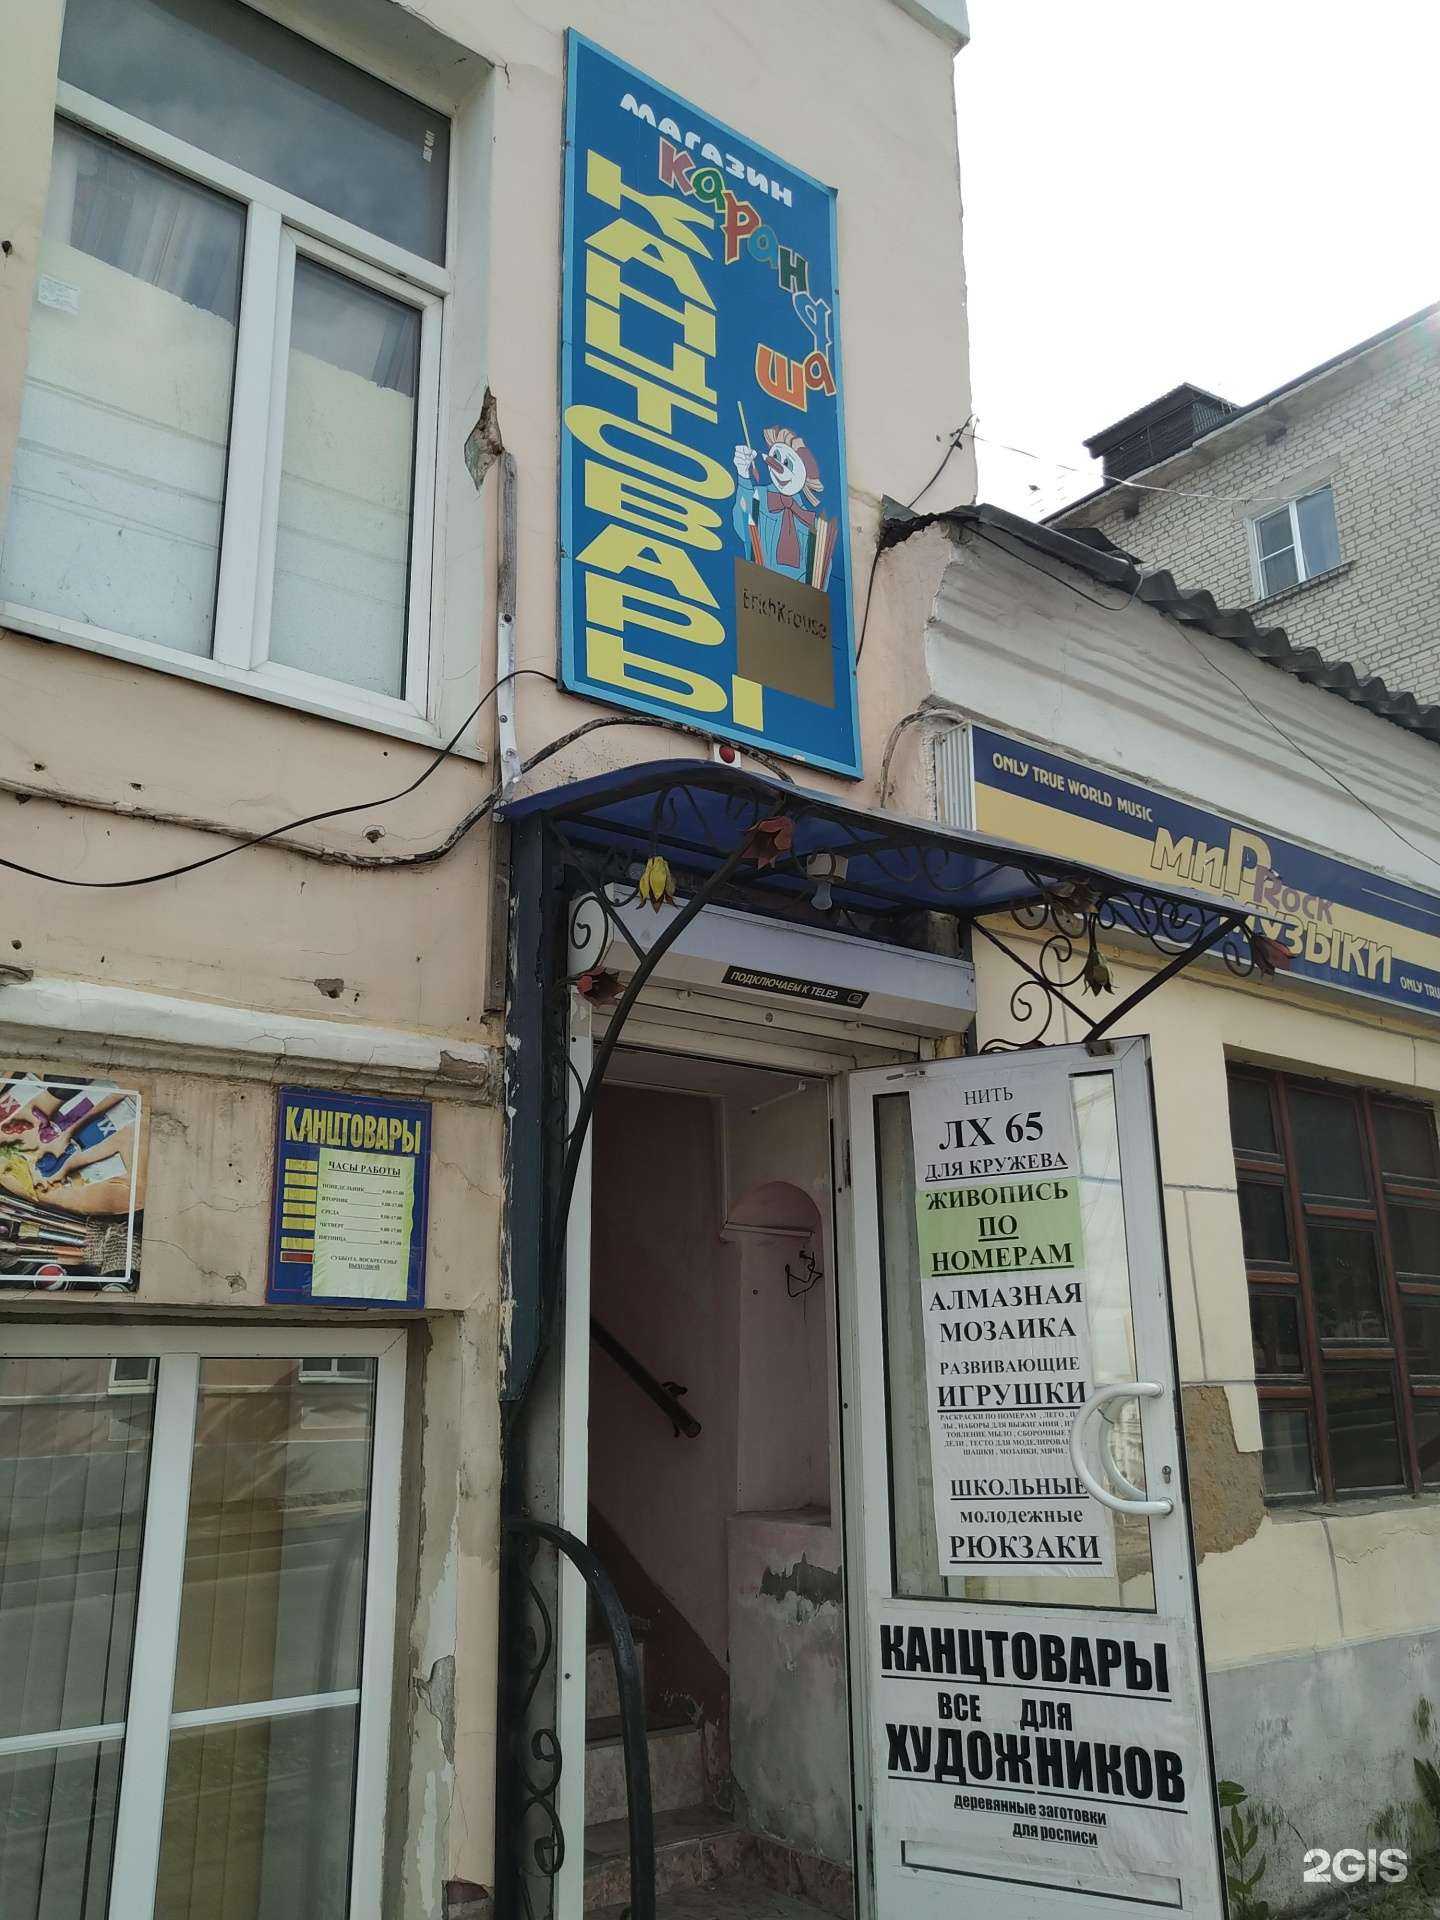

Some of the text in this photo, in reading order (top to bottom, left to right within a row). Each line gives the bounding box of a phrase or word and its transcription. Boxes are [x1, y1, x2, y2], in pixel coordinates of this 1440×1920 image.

[620, 93, 793, 208] МАГАЗИН
[564, 148, 764, 732] КАНЦТОВАРЫ
[992, 752, 1153, 823] ONLY TRUE WORLD MUSIC
[731, 971, 800, 993] ПОДКЛЮЧАЕМ
[811, 987, 839, 1000] TELE2
[1400, 976, 1422, 994] ONLY
[964, 1087, 1013, 1106] НИТЬ
[285, 1106, 422, 1154] КАНЦТОВАРЫ
[939, 1111, 1044, 1150] ЛХ 65
[329, 1161, 400, 1176] ЧАСЫ РАБОТЫ
[925, 1152, 1067, 1180] ДЛЯ КРУЖЕВА
[926, 1181, 1068, 1211] ЖИВОПИСЬ
[978, 1215, 1018, 1237] ПО
[931, 1243, 1072, 1272] НОМЕРАМ
[929, 1282, 1082, 1312] АЛМАЗНАЯ
[940, 1357, 1080, 1375] РАЗВИВАЮЩИЕ
[937, 1382, 1086, 1407] ИГРУШКИ
[950, 1477, 1088, 1497] ШКОЛЬНЫЕ
[960, 1509, 1083, 1525] молодежные
[949, 1535, 1100, 1559] РЮКЗАКИ
[880, 1624, 1170, 1693] КАНЦТОВАРЫ
[937, 1692, 1073, 1731] ВСЕ ДЛЯ
[885, 1723, 1186, 1804] ХУДОЖНИКОВ
[954, 1794, 1107, 1826] деревянные заготовки
[1013, 1823, 1098, 1846] для росписи
